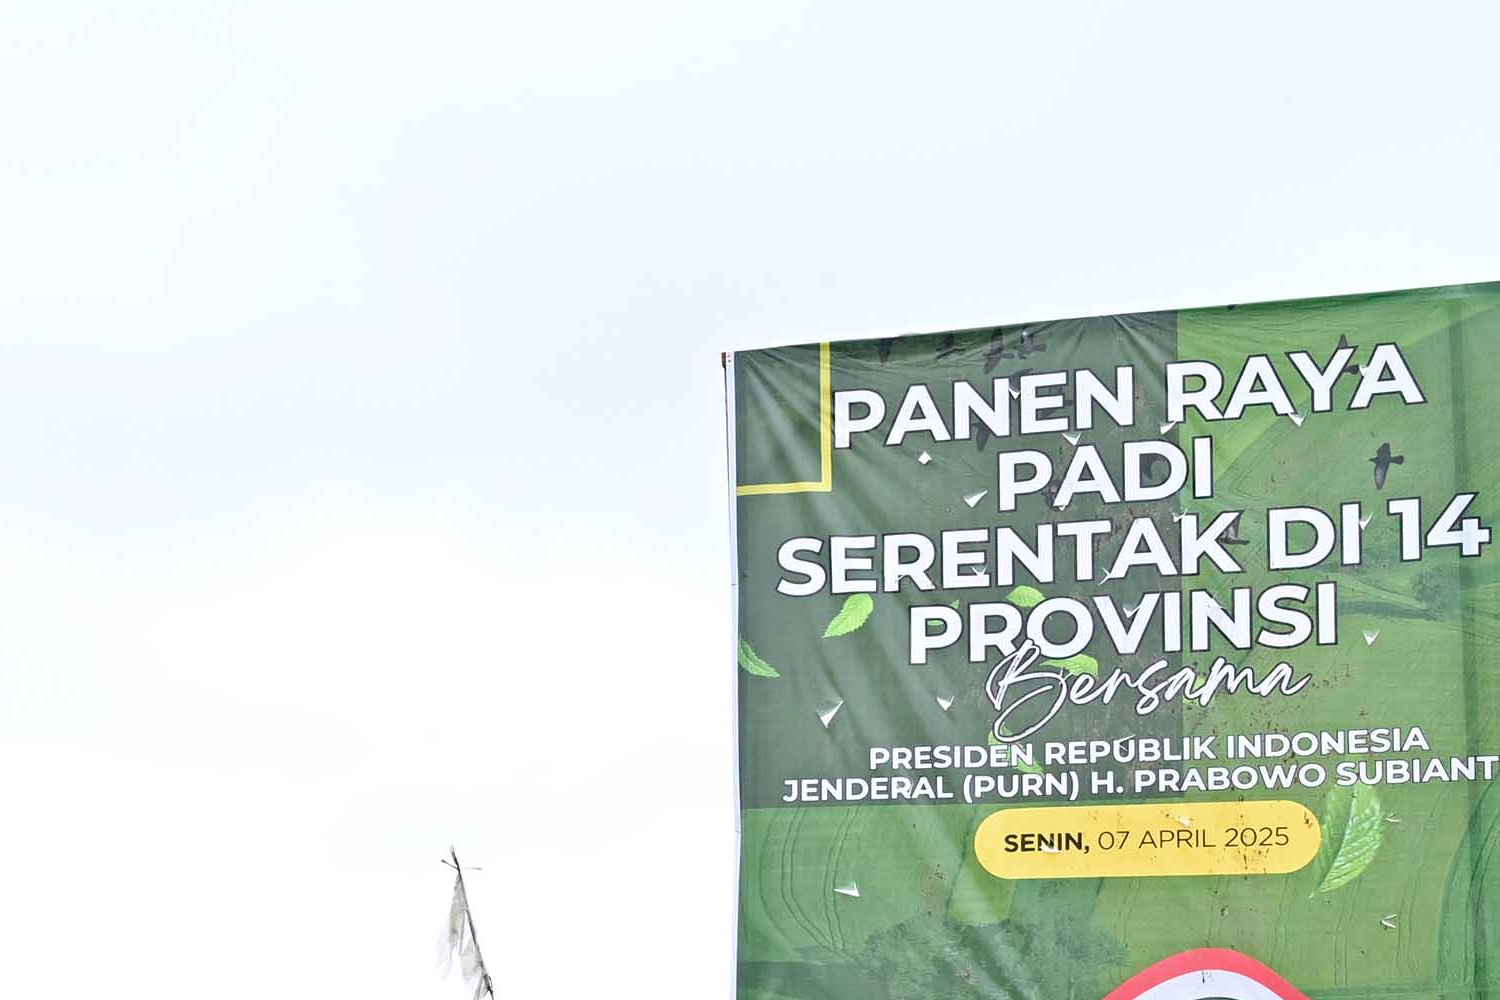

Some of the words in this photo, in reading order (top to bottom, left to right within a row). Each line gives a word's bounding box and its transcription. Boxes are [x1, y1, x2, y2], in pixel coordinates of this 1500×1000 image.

[833, 366, 1135, 449] PANEN
[1166, 343, 1426, 423] RAYA
[998, 436, 1214, 512] PADI
[776, 511, 1243, 597] SERENTAK
[1267, 501, 1362, 572] DI
[1388, 492, 1492, 562] 14
[908, 582, 1339, 666] PROVINSI
[985, 639, 1312, 743] Bersama
[783, 776, 954, 803] JENDERAL
[962, 771, 1079, 804] (PURN)
[1091, 770, 1125, 796] H.
[1134, 762, 1327, 793] PRABOWO
[869, 744, 1034, 770] PRESIDEN
[1044, 738, 1217, 765] REPUBLIK
[1226, 727, 1430, 758] INDONESIA
[1004, 832, 1091, 855] SENIN,
[1098, 832, 1131, 853] 07
[1138, 829, 1217, 850] APRIL
[1224, 827, 1290, 848] 2025
